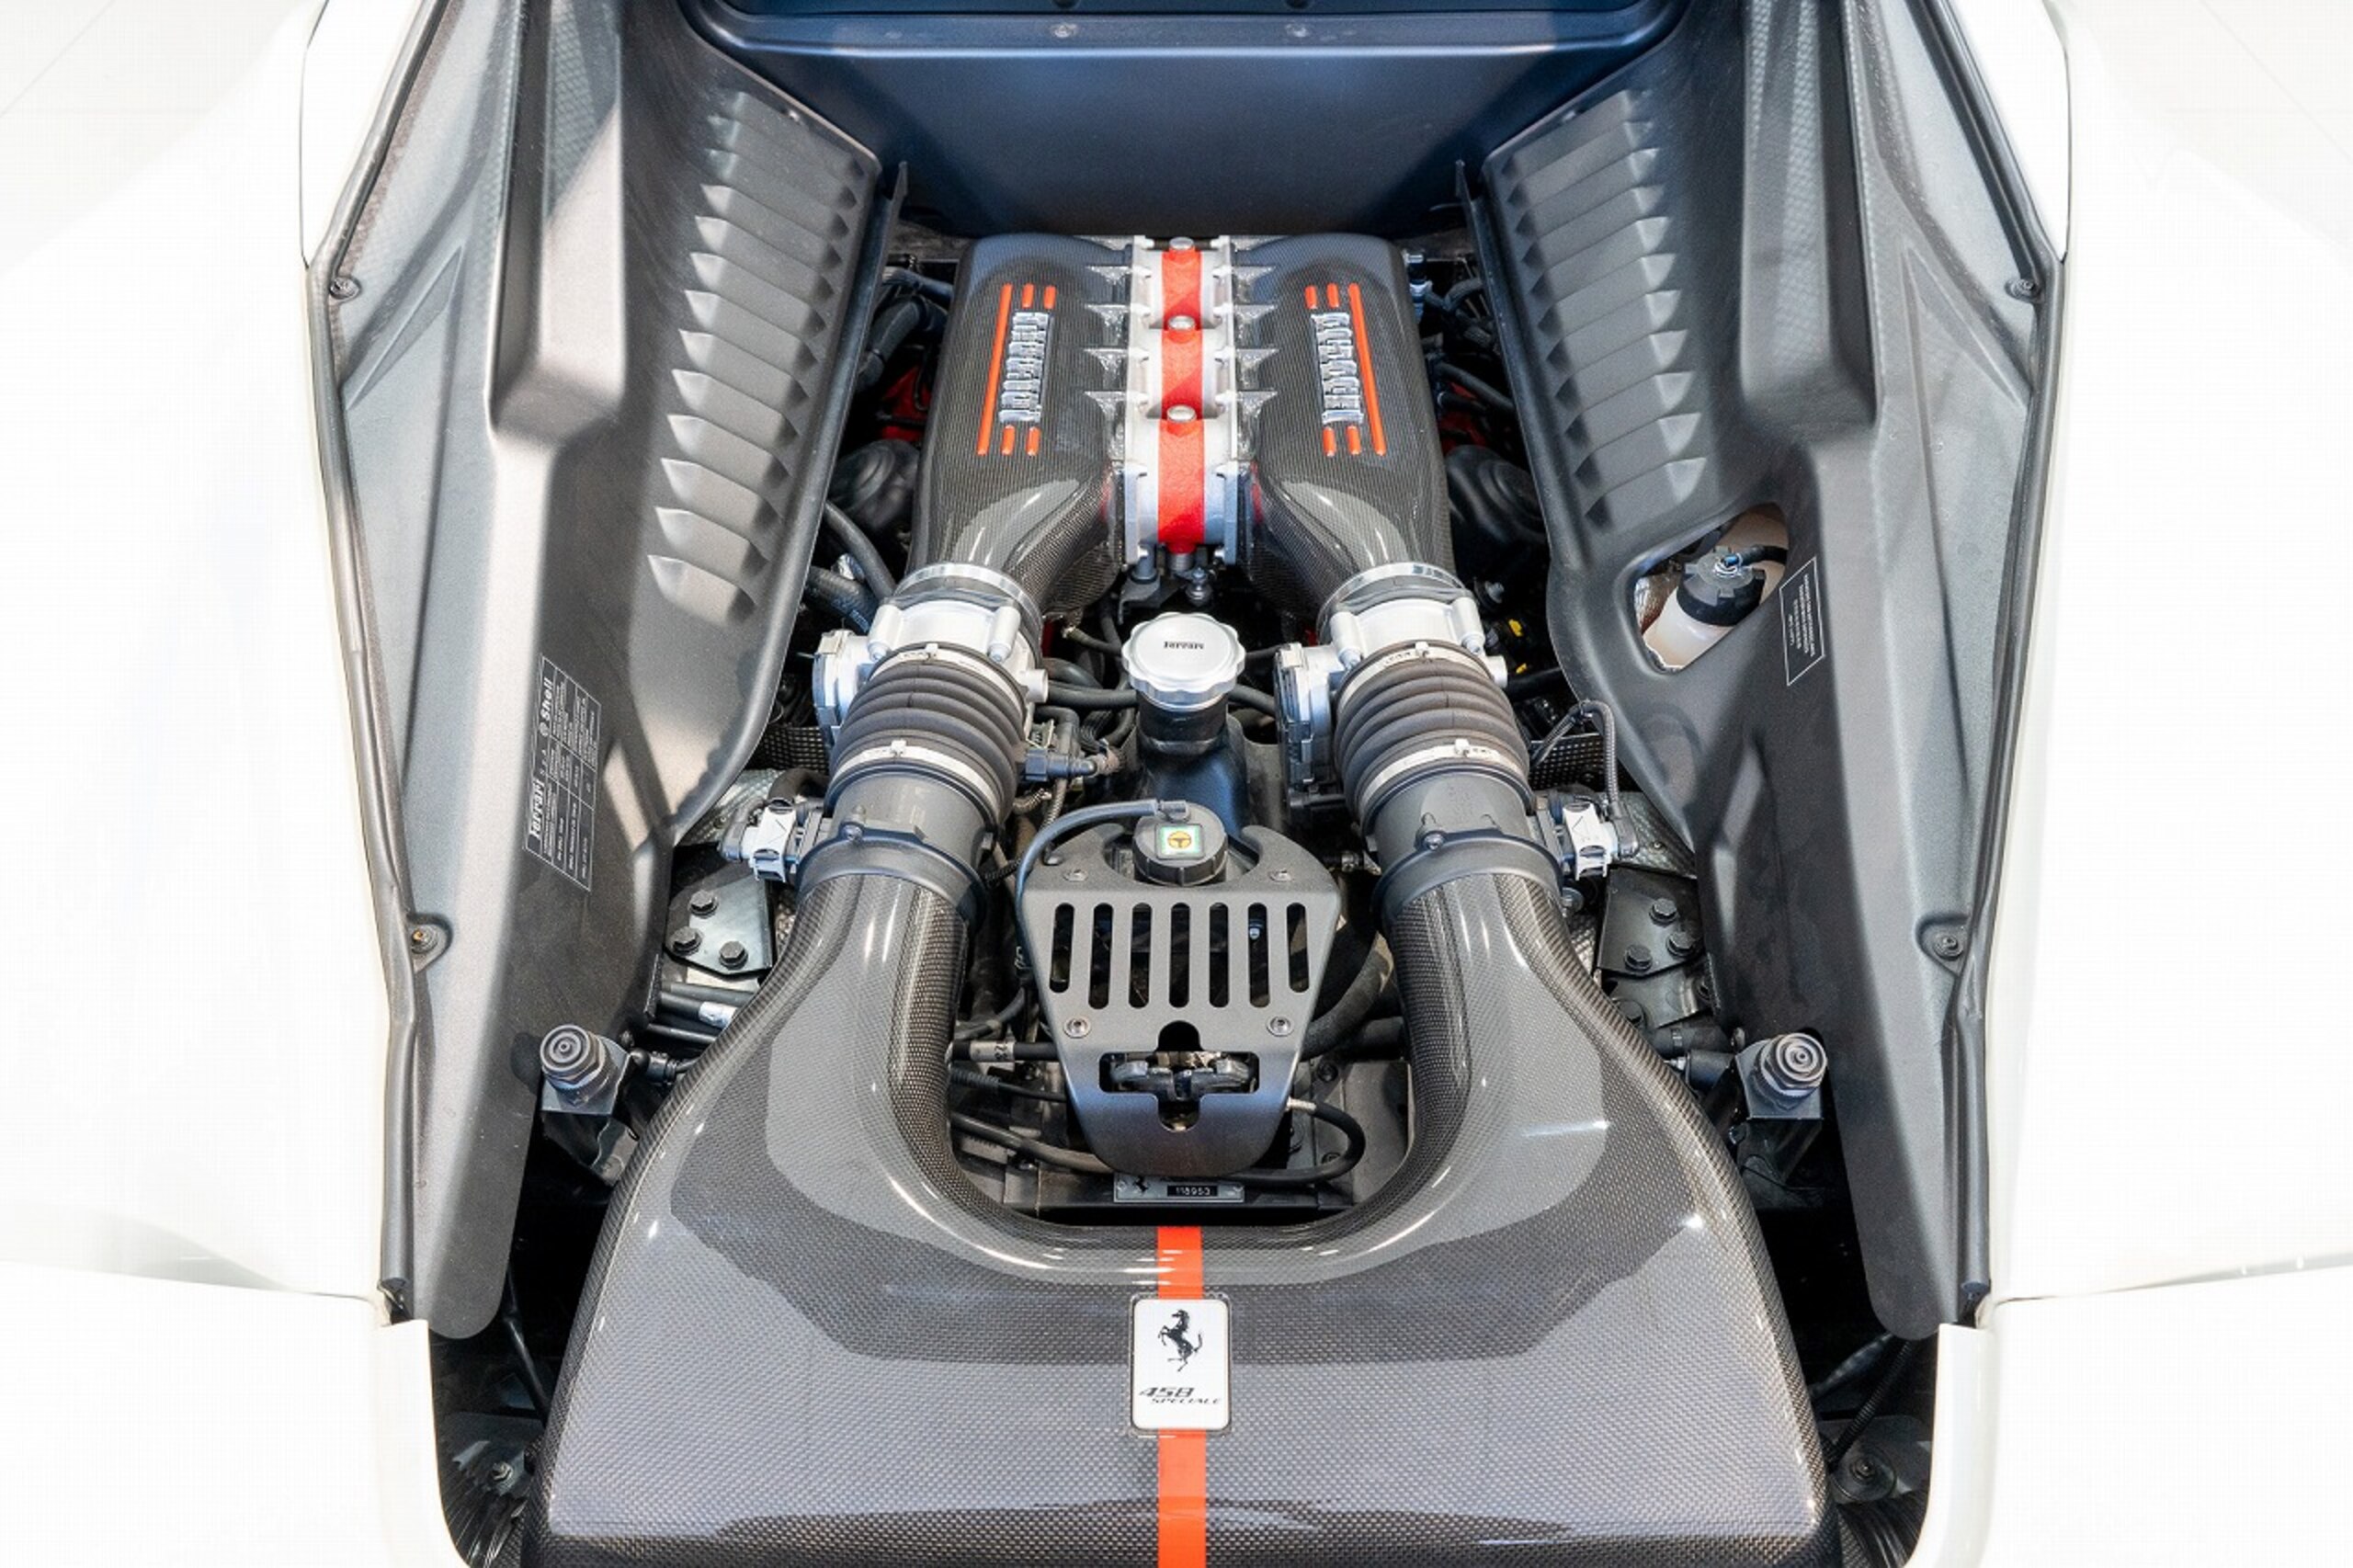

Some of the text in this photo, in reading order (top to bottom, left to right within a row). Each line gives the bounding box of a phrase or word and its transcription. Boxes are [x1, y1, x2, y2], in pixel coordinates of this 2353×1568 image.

[1163, 641, 1205, 650] Ferrari
[529, 778, 545, 838] Ferrari
[540, 676, 553, 722] Shell
[1139, 1387, 1195, 1398] 458
